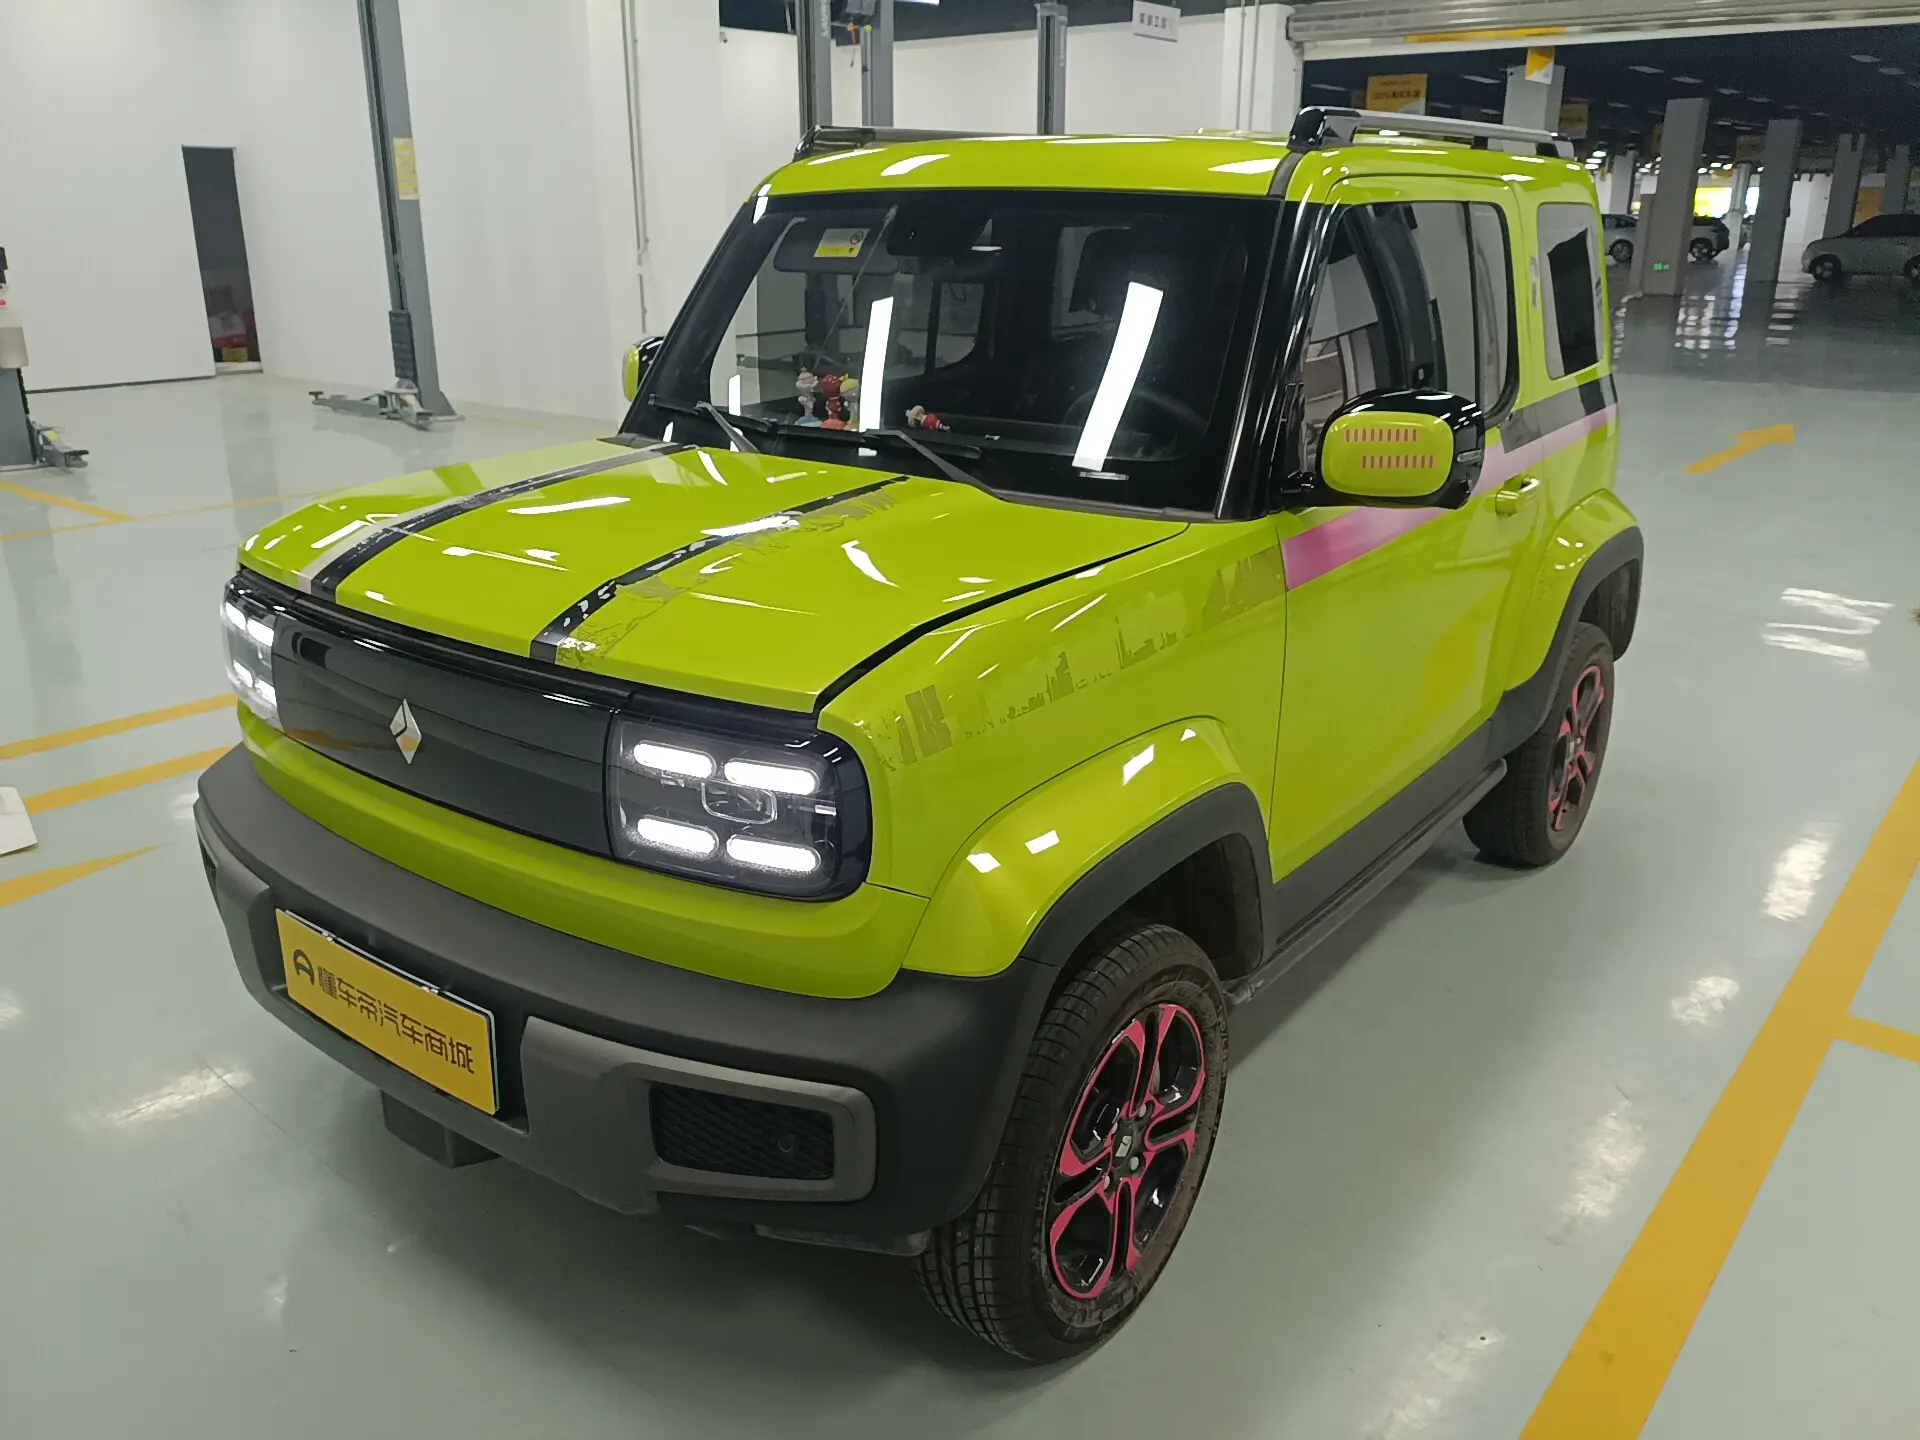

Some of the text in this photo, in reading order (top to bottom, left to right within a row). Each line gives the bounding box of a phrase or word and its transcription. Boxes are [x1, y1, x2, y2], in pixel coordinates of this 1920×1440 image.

[317, 966, 475, 1074] 懂车帝汽车商城
